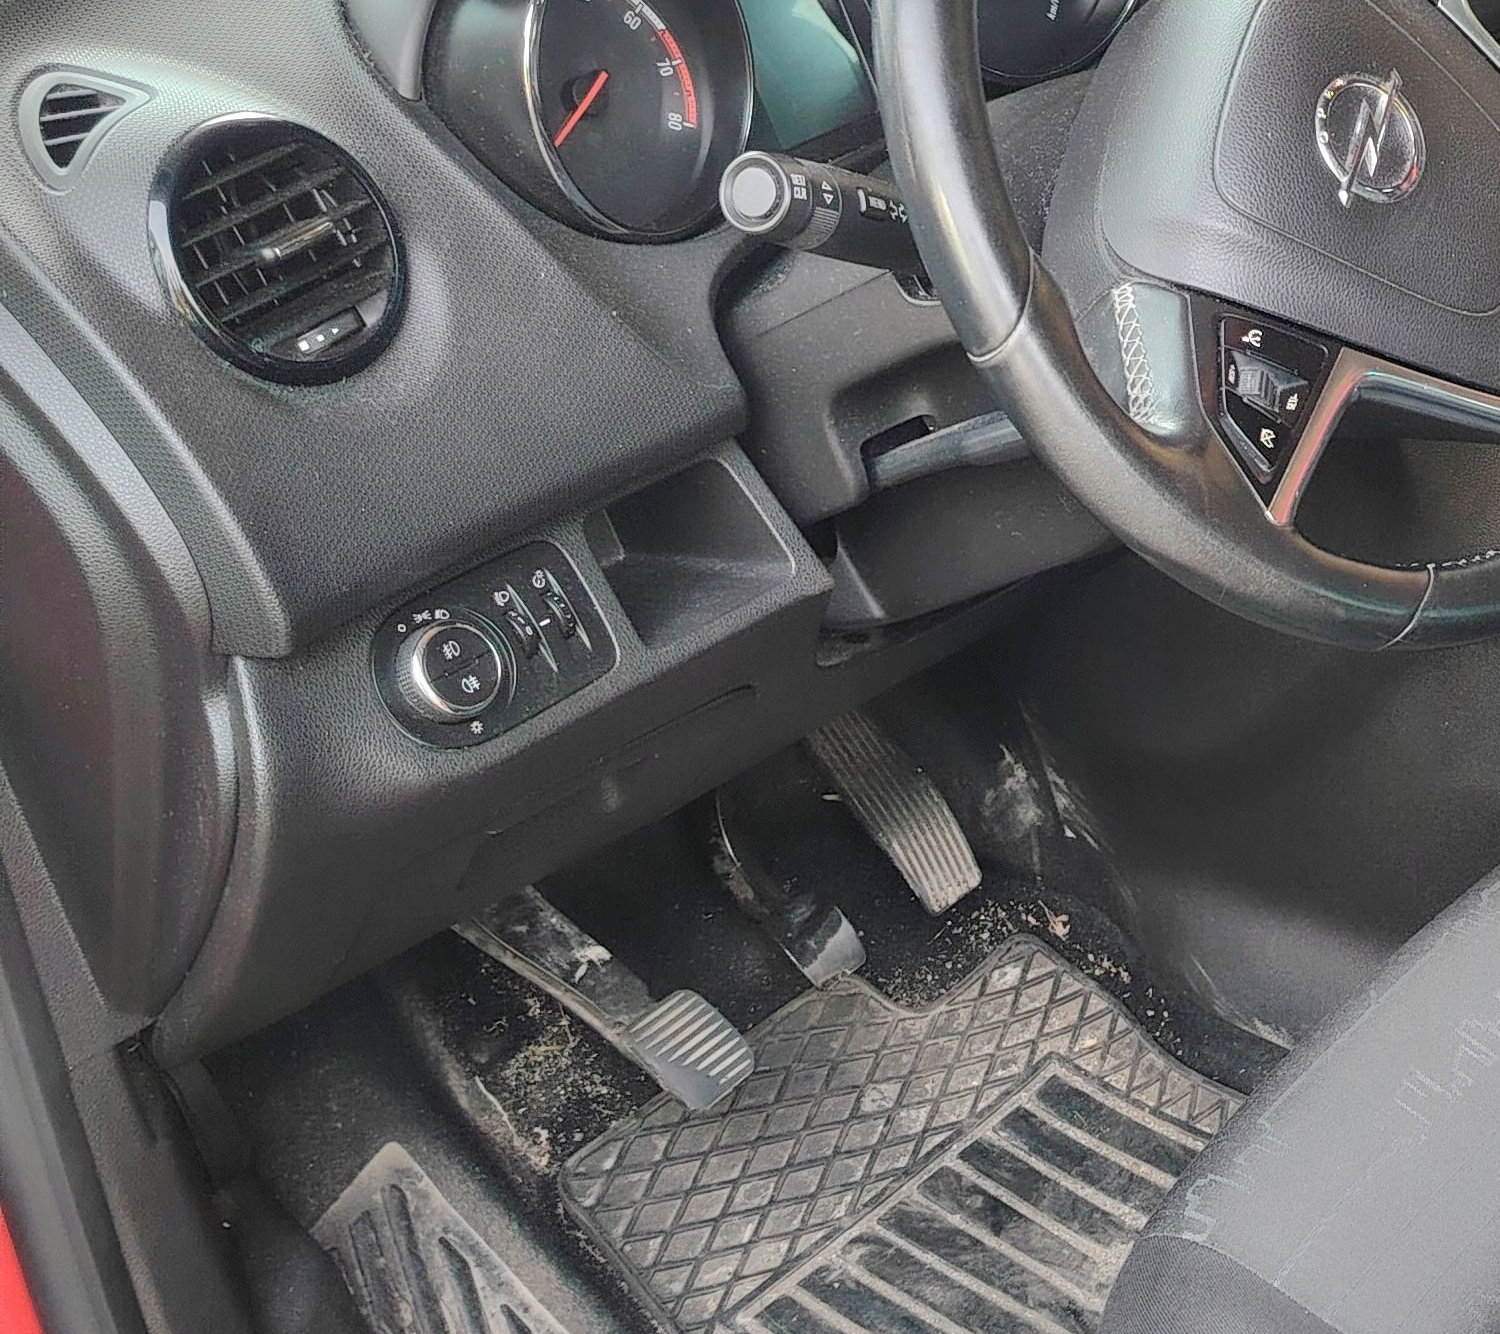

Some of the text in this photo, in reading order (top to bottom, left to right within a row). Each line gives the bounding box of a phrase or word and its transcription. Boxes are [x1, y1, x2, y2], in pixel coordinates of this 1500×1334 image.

[623, 10, 642, 31] 60
[656, 57, 674, 77] 70
[668, 112, 683, 131] 80
